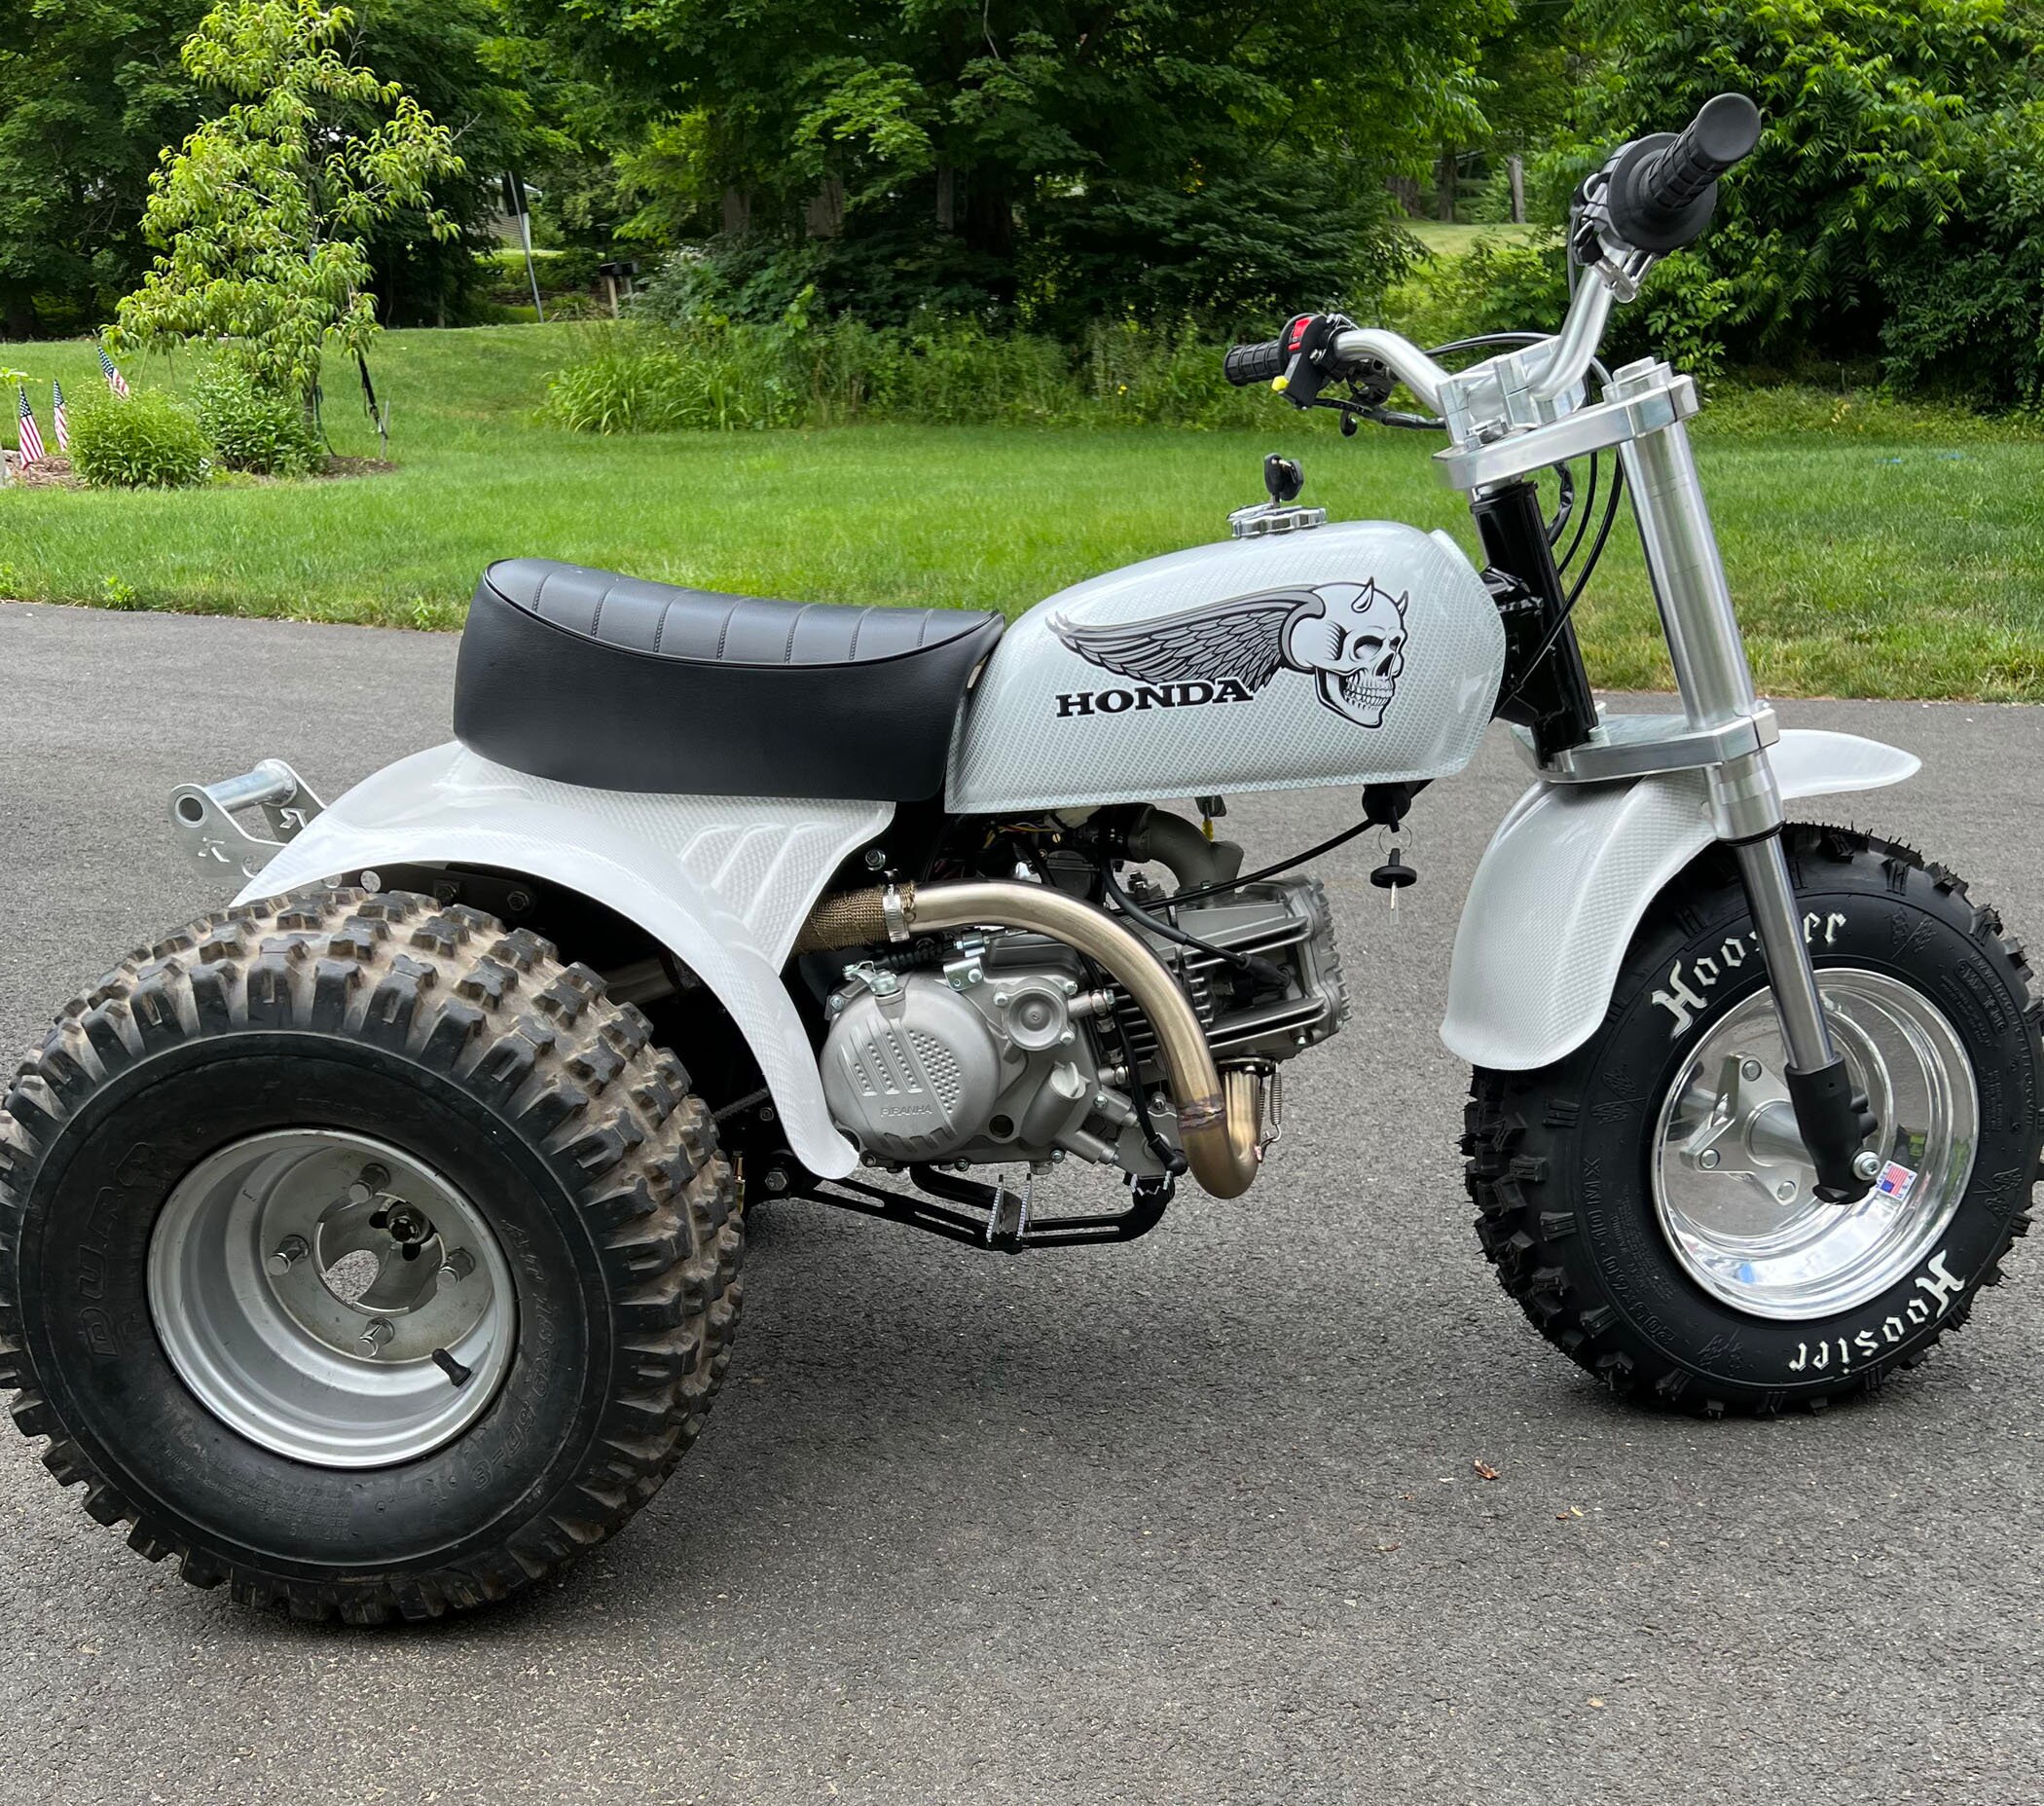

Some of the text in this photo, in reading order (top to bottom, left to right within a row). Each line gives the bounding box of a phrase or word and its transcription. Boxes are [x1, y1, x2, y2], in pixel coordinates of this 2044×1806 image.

[1055, 679, 1254, 718] HONDA
[1651, 910, 1847, 1041] Hooer
[880, 1104, 932, 1118] PIRANHA
[1788, 1249, 1966, 1375] Hoosier
